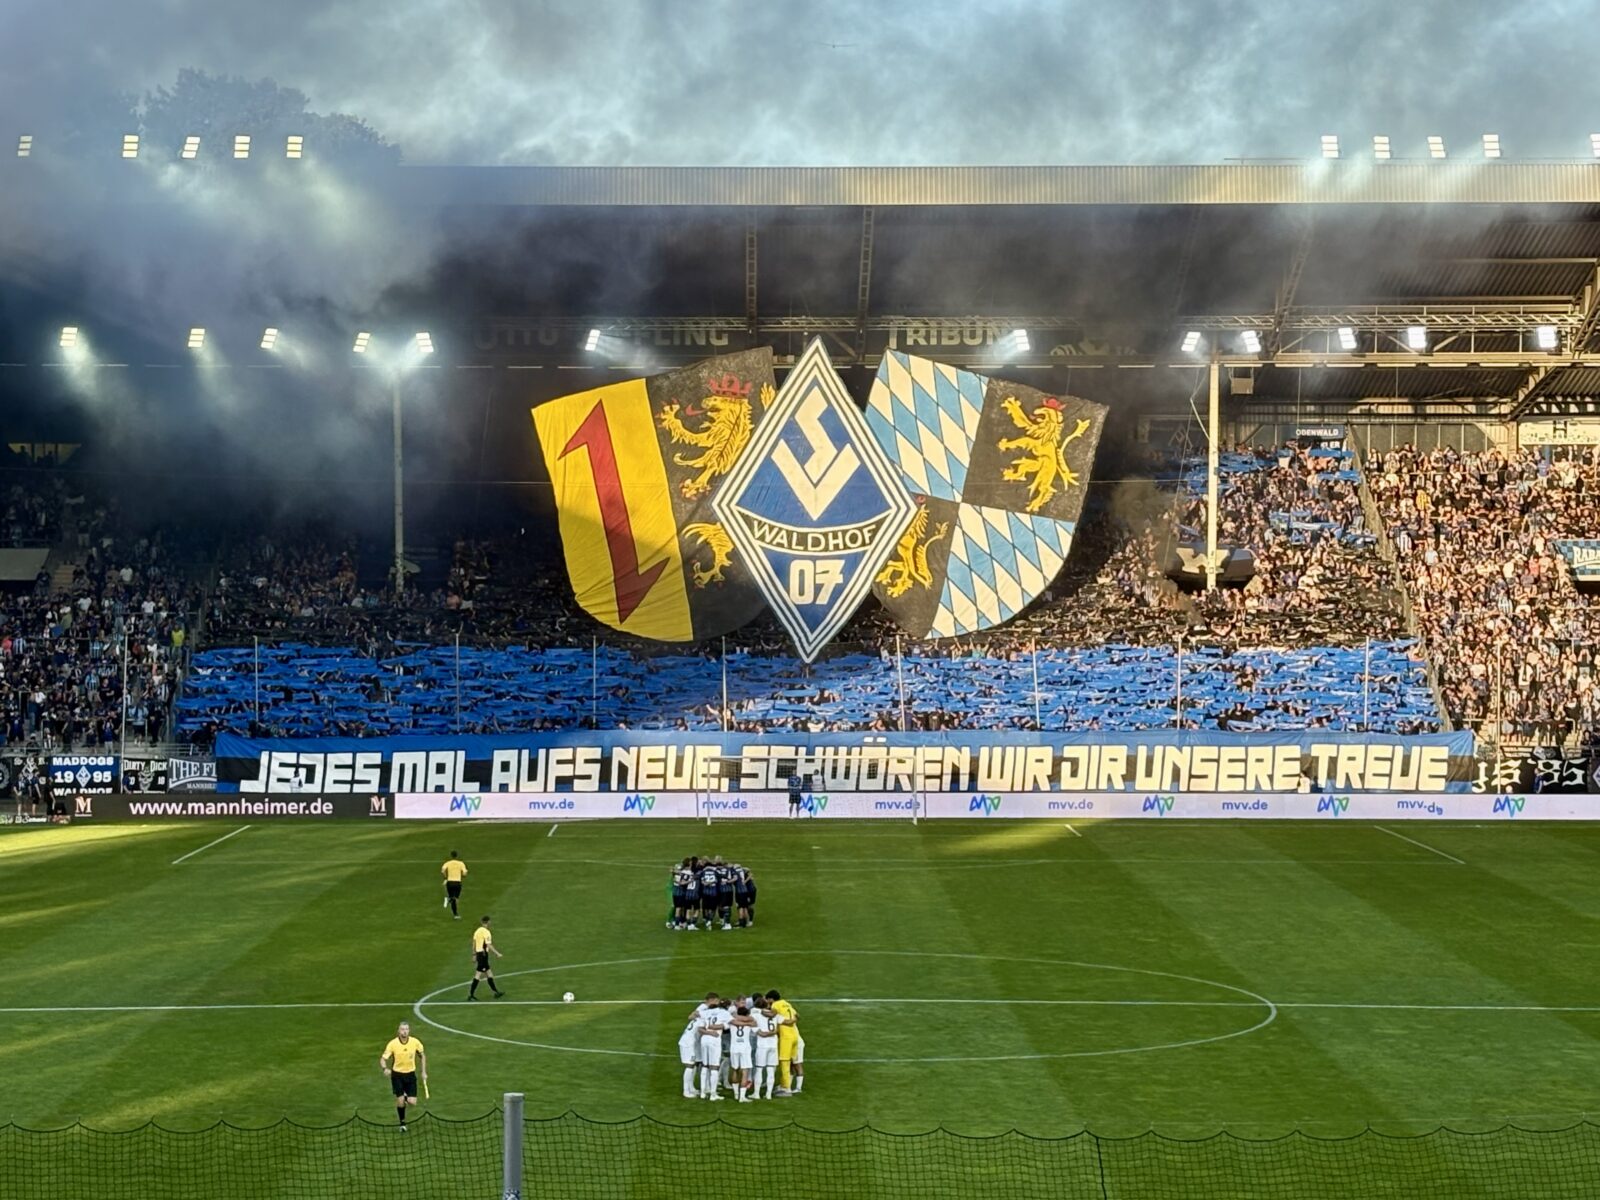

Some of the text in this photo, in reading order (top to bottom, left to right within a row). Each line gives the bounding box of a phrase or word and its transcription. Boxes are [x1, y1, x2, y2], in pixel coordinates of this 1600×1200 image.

[1295, 428, 1339, 436] ODENWALD
[753, 520, 877, 550] WALDHOF
[789, 559, 846, 605] 07
[52, 757, 114, 766] MADDOGS
[123, 759, 145, 771] DIRTY
[239, 750, 382, 793] JEDES
[390, 750, 480, 793] MAL
[491, 746, 602, 793] AUFS
[740, 736, 971, 792] SCHWÖREN
[977, 745, 1054, 791] WIR
[1060, 745, 1128, 790] DIR
[1135, 745, 1301, 792] UNSERE
[1310, 743, 1449, 791] TREUE
[169, 757, 200, 781] THE
[54, 771, 74, 783] 19
[92, 771, 112, 783] 95
[129, 797, 334, 816] www.mannheimer.de
[528, 798, 575, 810] mvv.de
[702, 798, 748, 809] mvv.de
[1048, 799, 1094, 810] mvv.de
[1222, 799, 1268, 810] mvv.de
[768, 1017, 775, 1032] 6
[736, 1025, 744, 1037] 8
